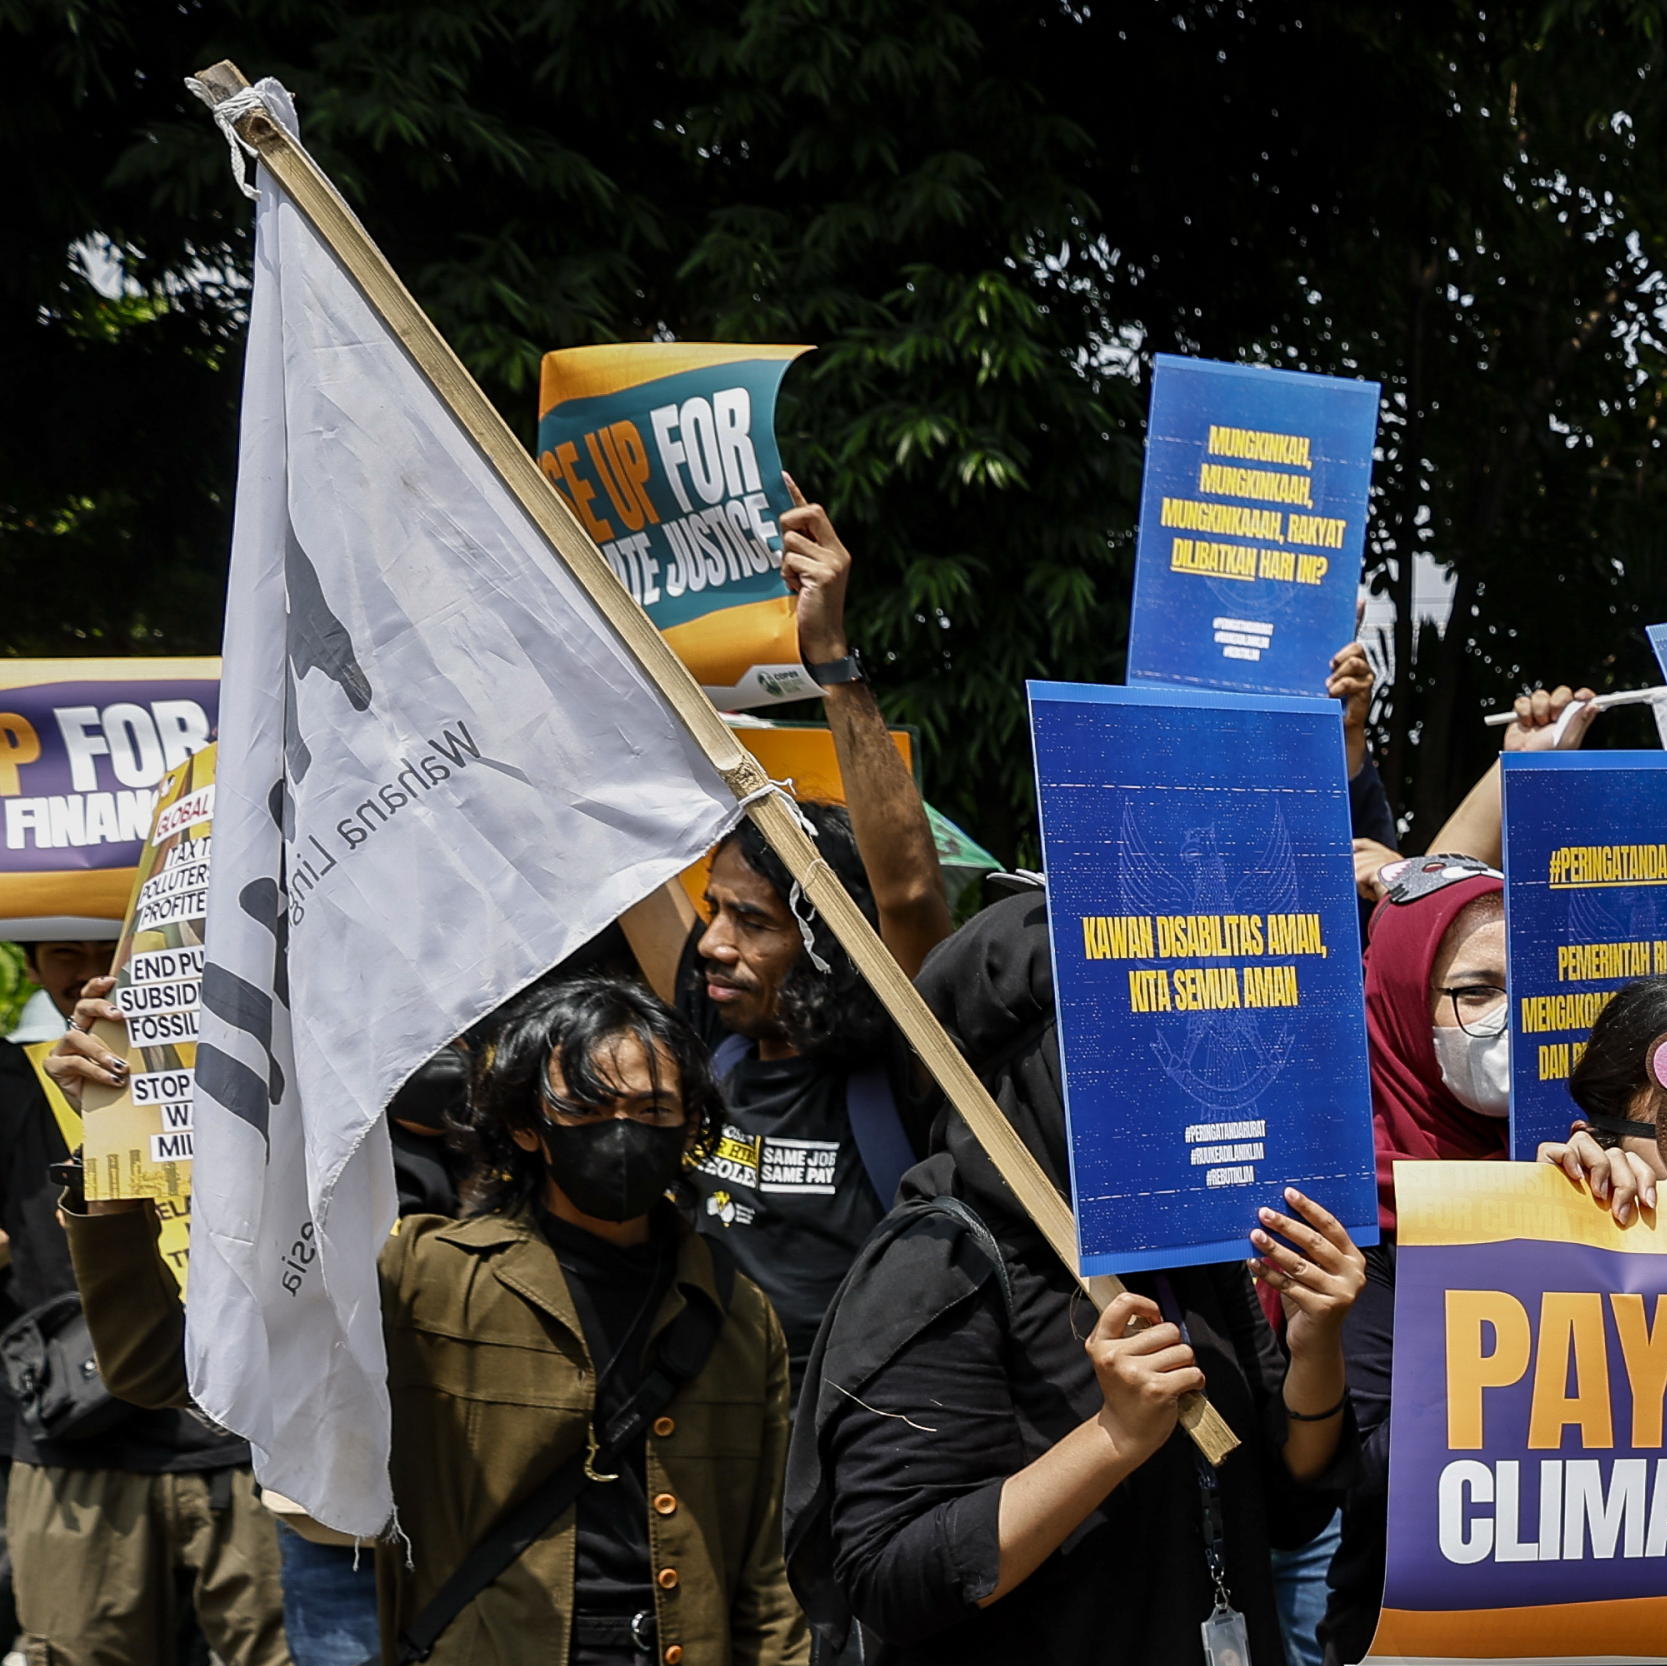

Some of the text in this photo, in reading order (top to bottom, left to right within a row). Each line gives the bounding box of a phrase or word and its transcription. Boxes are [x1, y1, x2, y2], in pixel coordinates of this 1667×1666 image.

[584, 419, 662, 531] UP
[650, 386, 763, 514] FOR
[1207, 423, 1314, 472] MUNGKINKAH,
[1199, 461, 1315, 510] MUNGKINKAAH,
[661, 491, 784, 598] JUSTICE
[1160, 496, 1347, 550] MUNGKINKAAAH, RAKYAT
[1171, 537, 1329, 586] DILIBATKAN HARI INI?
[53, 699, 210, 793] FOR
[156, 793, 209, 838] GLOBAL
[140, 861, 210, 903] POLLUTER
[1082, 913, 1328, 960] KAWAN DISABILITAS AMAN,
[133, 955, 176, 981] END
[1557, 940, 1651, 982] PEMERINTAH
[1653, 939, 1667, 976] RI
[1128, 965, 1299, 1013] KITA SEMUA AMAN
[129, 1011, 199, 1042] FOSSIL
[1538, 1043, 1570, 1082] DAN
[134, 1073, 191, 1100] STOP
[760, 1164, 804, 1184] SAME
[805, 1166, 836, 1184] PAY
[763, 1146, 807, 1167] SAME
[807, 1150, 837, 1168] JOB
